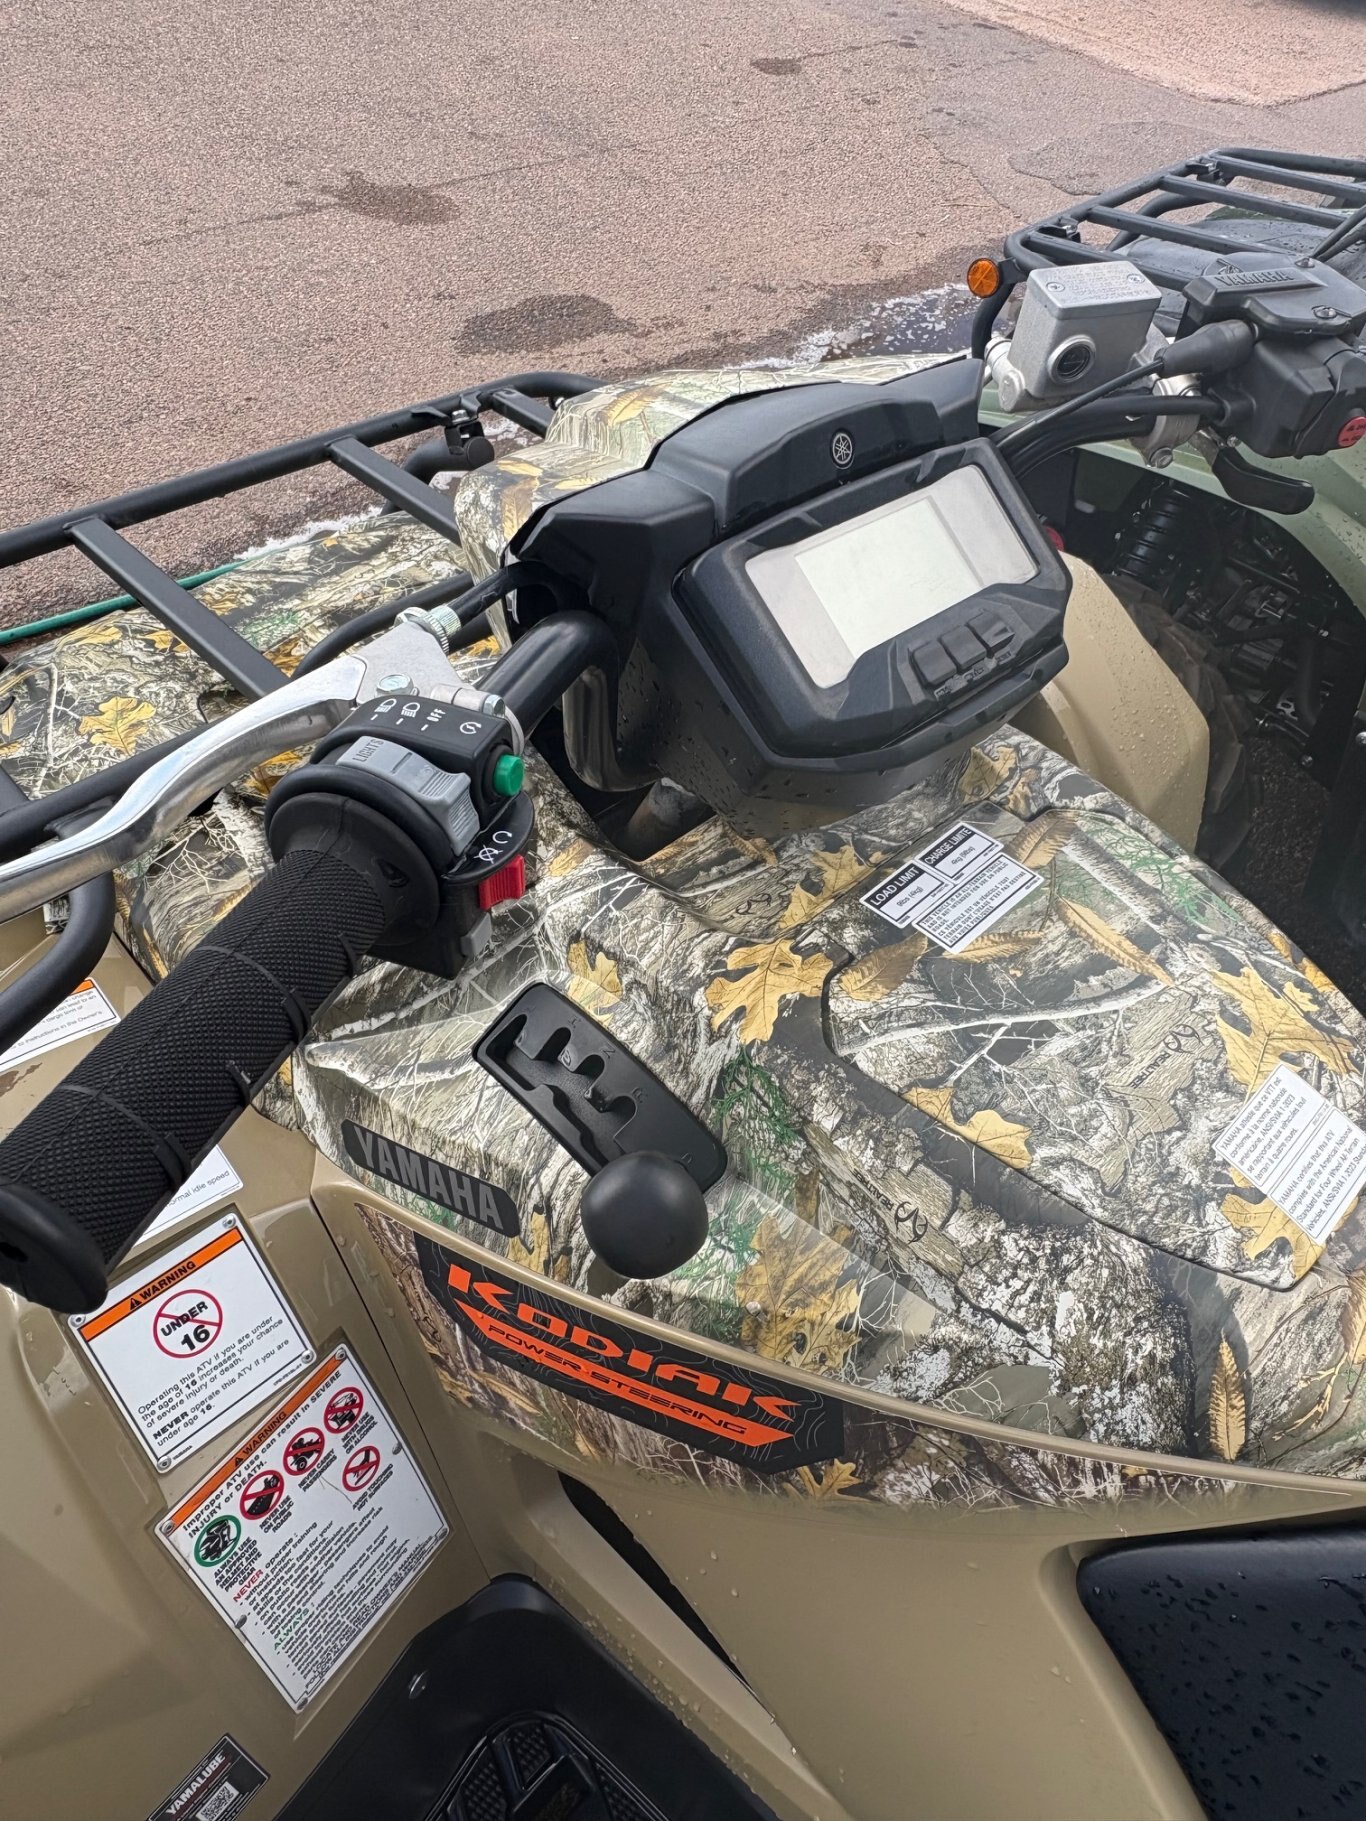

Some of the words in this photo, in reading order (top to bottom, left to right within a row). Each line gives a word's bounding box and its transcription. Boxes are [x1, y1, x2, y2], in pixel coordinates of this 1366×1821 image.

[1215, 271, 1294, 286] YAMAHA
[426, 708, 446, 722] OFF
[352, 739, 384, 762] LIGHTS
[923, 841, 954, 864] CHARGE
[948, 827, 971, 845] LIMITE
[868, 883, 898, 905] LOAD
[893, 866, 920, 886] LIMIT
[1130, 1050, 1171, 1089] REALTREE
[1219, 1125, 1242, 1150] YAMAHA
[190, 1182, 206, 1192] idle
[206, 1170, 230, 1185] speed
[353, 1125, 505, 1231] YAMAHA
[852, 1167, 894, 1211] REALTREE
[1276, 1179, 1300, 1205] YAMAHA
[139, 1259, 196, 1301] WARNING
[159, 1299, 208, 1337] UNDER
[178, 1321, 212, 1353] 16
[446, 1263, 802, 1421] KODIAK
[136, 1381, 180, 1416] Operating
[179, 1370, 195, 1385] this
[195, 1357, 213, 1373] ATV
[213, 1352, 220, 1360] if
[220, 1342, 237, 1357] you
[236, 1332, 250, 1344] are
[250, 1315, 273, 1334] under
[141, 1408, 156, 1421] the
[157, 1396, 174, 1411] age
[173, 1388, 184, 1398] of
[184, 1378, 198, 1390] 16
[198, 1351, 236, 1381] increases
[237, 1338, 255, 1354] your
[255, 1317, 283, 1340] chance
[487, 1324, 580, 1373] POWER
[588, 1370, 748, 1436] STEERING
[145, 1418, 155, 1428] of
[156, 1398, 184, 1421] severe
[184, 1380, 209, 1401] injury
[208, 1374, 218, 1383] or
[218, 1354, 244, 1376] death.
[152, 1410, 189, 1439] NEVER
[189, 1388, 221, 1414] operate
[220, 1376, 236, 1390] this
[235, 1363, 253, 1379] ATV
[260, 1348, 276, 1362] you
[276, 1338, 289, 1350] are
[156, 1426, 182, 1447] under
[182, 1414, 199, 1429] age
[199, 1401, 215, 1415] 16.
[242, 1410, 287, 1456] WARNING
[341, 1422, 359, 1443] NEVER
[358, 1411, 369, 1424] USE
[342, 1432, 357, 1449] WITH
[356, 1414, 374, 1435] DRUGS
[345, 1443, 354, 1454] OR
[353, 1419, 377, 1446] ALCOHOL
[182, 1488, 225, 1532] Improper
[224, 1469, 243, 1489] ATV
[243, 1453, 260, 1470] use
[260, 1436, 276, 1454] can
[276, 1411, 301, 1437] result
[300, 1402, 310, 1413] in
[309, 1369, 341, 1403] SEVERE
[297, 1467, 317, 1488] NEVER
[315, 1448, 335, 1469] CARRY
[302, 1453, 337, 1492] PASSENGERS
[187, 1501, 223, 1539] INJURY
[223, 1490, 234, 1503] or
[234, 1457, 267, 1492] DEATH.
[259, 1507, 279, 1529] NEVER
[277, 1494, 291, 1509] USE
[262, 1522, 273, 1534] ON
[271, 1499, 294, 1524] PUBLIC
[271, 1510, 292, 1533] ROADS
[212, 1550, 238, 1578] ALWAYS
[237, 1536, 251, 1551] USE
[214, 1573, 225, 1585] AN
[224, 1538, 257, 1575] APPROVED
[219, 1560, 245, 1589] HELMET
[243, 1546, 258, 1562] AND
[224, 1550, 262, 1592] PROTECTIVE
[232, 1568, 264, 1603] NEVER
[264, 1536, 294, 1570] operate
[237, 1566, 256, 1586] GEAR
[243, 1572, 270, 1601] without
[269, 1547, 293, 1574] proper
[291, 1520, 317, 1550] training
[251, 1601, 260, 1611] at
[259, 1574, 285, 1603] speeds
[284, 1561, 296, 1575] too
[295, 1546, 309, 1563] fast
[308, 1535, 319, 1548] for
[318, 1520, 334, 1538] your
[248, 1595, 257, 1606] or
[256, 1555, 294, 1597] instruction.
[272, 1606, 309, 1650] ALWAYS
[164, 1749, 228, 1818] YAMALUBE
